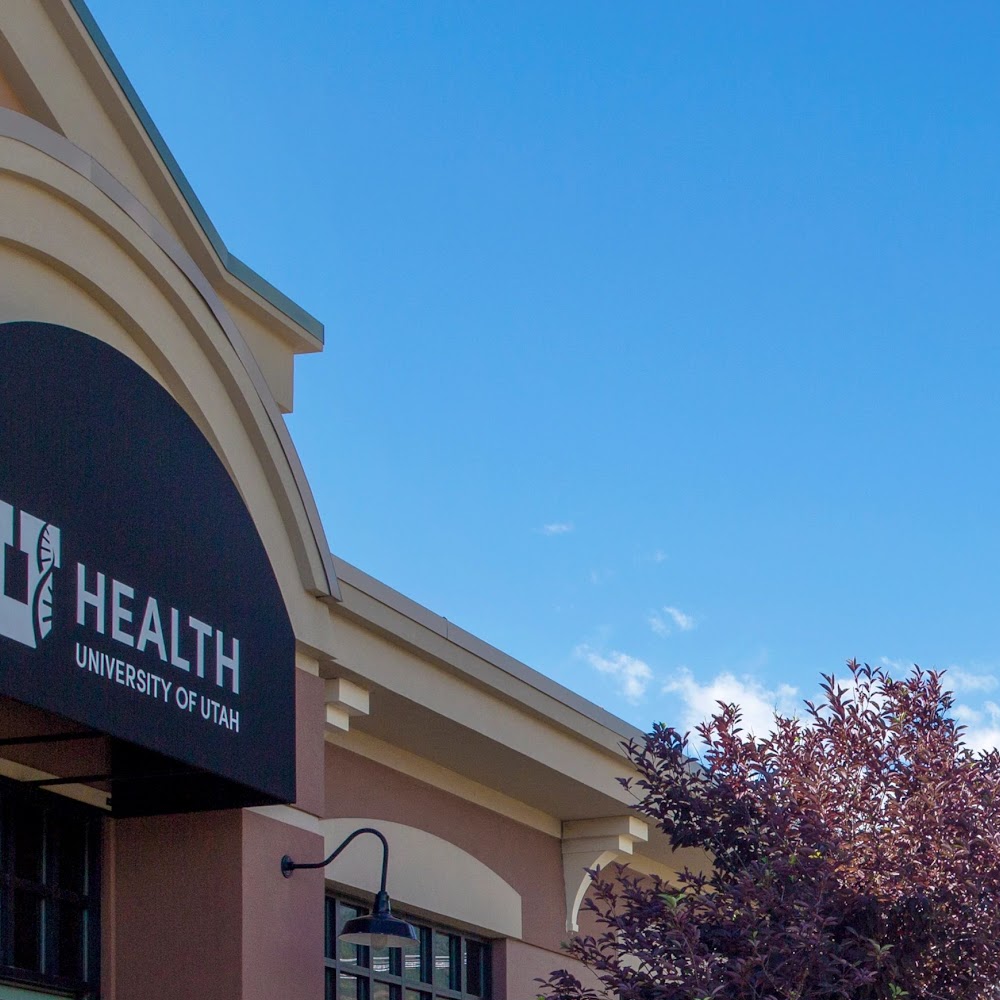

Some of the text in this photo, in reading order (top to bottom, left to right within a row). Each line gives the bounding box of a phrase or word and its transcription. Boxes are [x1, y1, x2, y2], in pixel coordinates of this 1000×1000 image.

[76, 562, 240, 695] HEALTH
[75, 642, 240, 733] UNIVERSITY OF UTAH
